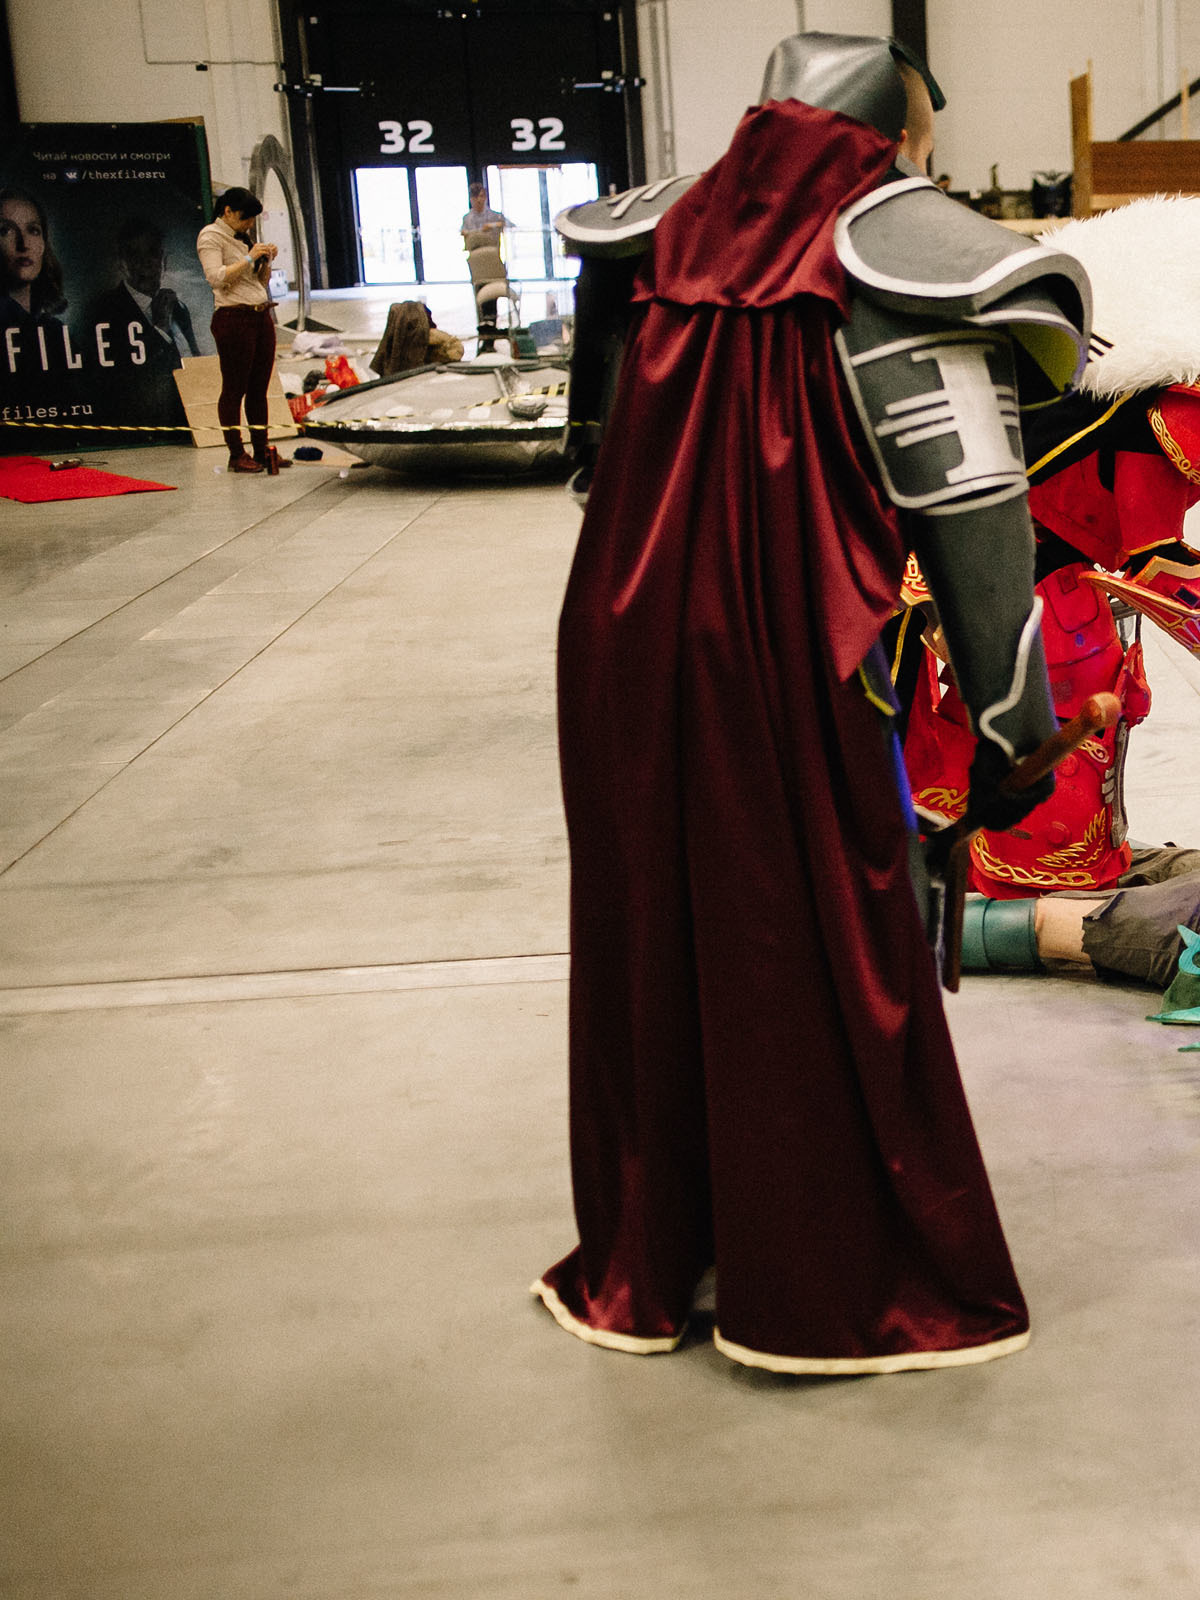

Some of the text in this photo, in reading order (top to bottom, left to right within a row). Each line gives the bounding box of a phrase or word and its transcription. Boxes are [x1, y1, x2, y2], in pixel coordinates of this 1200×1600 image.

[378, 120, 435, 154] 32
[510, 117, 566, 151] 32
[33, 151, 67, 161] Читай
[71, 152, 118, 161] новости
[130, 152, 171, 162] смотри
[43, 172, 57, 180] на
[5, 321, 146, 373] FILES
[2, 404, 93, 420] files.ru
